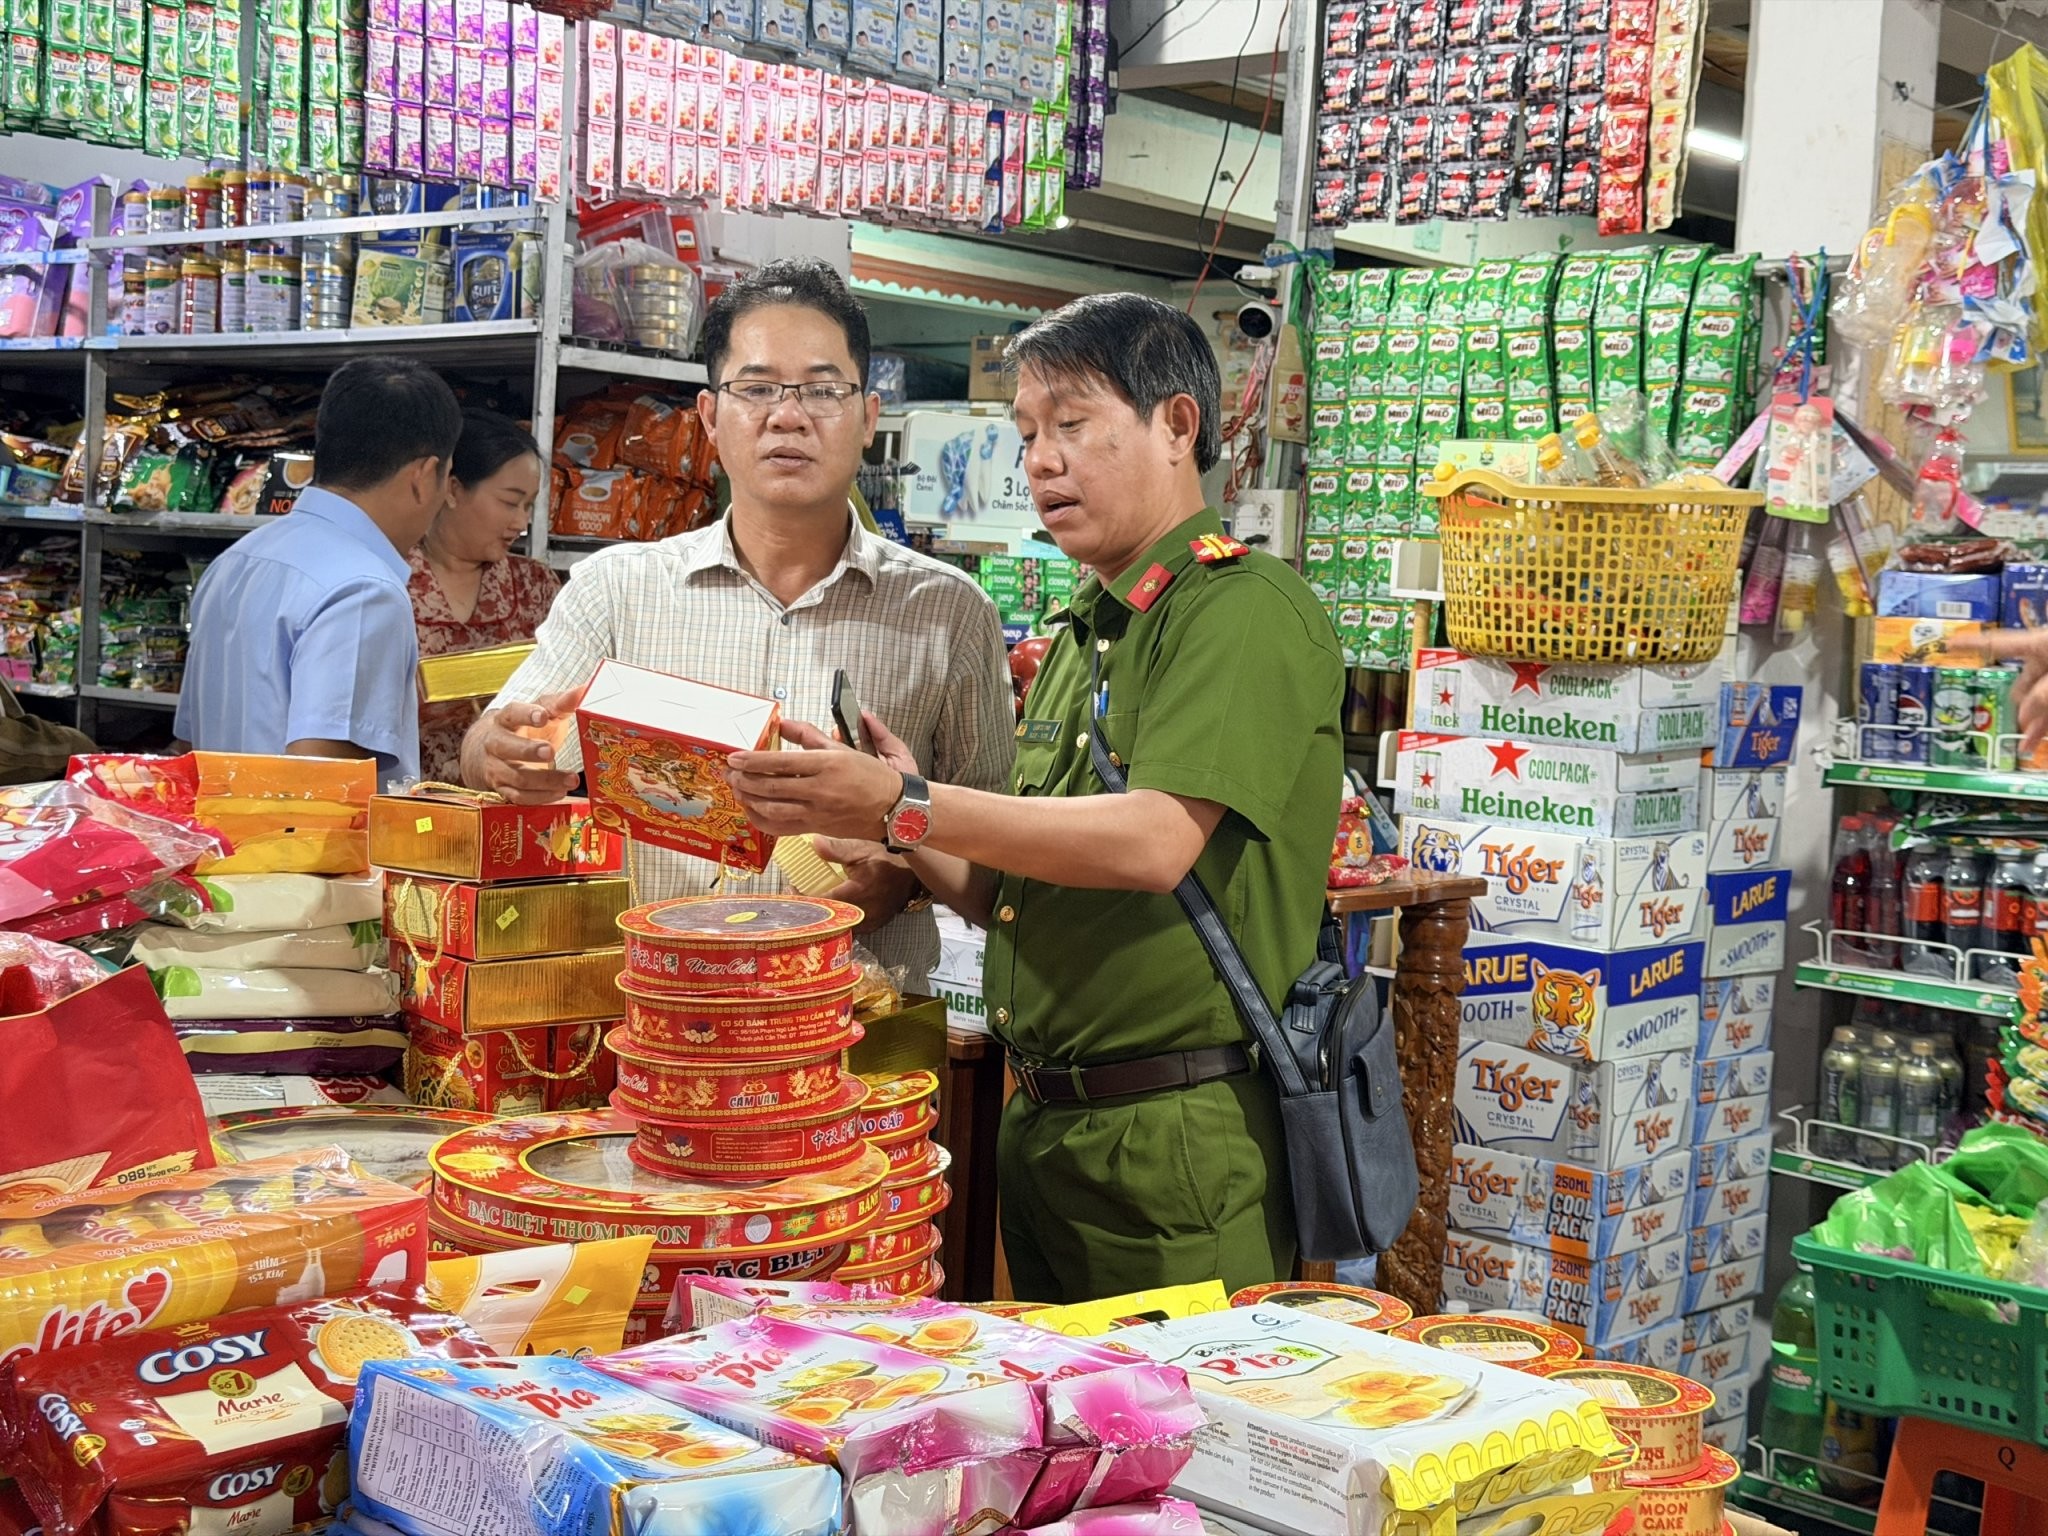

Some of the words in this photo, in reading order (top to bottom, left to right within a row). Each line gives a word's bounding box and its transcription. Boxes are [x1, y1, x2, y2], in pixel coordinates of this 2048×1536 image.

[1405, 272, 1429, 280] MILO
[1446, 270, 1469, 279] MILO
[1482, 266, 1506, 275] MILO
[1517, 270, 1542, 280] MILO
[1569, 266, 1593, 275] MILO
[1613, 269, 1638, 278] MILO
[1701, 322, 1730, 332] MILO
[1319, 346, 1341, 355] MILO
[1356, 340, 1376, 349] MILO
[1431, 339, 1455, 347] MILO
[1472, 337, 1495, 345] MILO
[1557, 336, 1580, 345] MILO
[1605, 342, 1629, 351] MILO
[1477, 407, 1500, 417] MILO
[1692, 397, 1722, 408] MILO
[1316, 414, 1339, 423] MILO
[1354, 409, 1373, 418] MILO
[1388, 410, 1409, 418] MILO
[1425, 409, 1450, 418] MILO
[1518, 414, 1544, 424] MILO
[1003, 477, 1013, 497] 3
[1313, 481, 1335, 489] MILO
[1015, 500, 1029, 512] Sóc
[1310, 548, 1331, 557] MILO
[1345, 546, 1364, 554] MILO
[1370, 615, 1394, 624] MILO
[1550, 674, 1612, 700] COOLPACK
[1480, 704, 1618, 743] Heineken
[1656, 711, 1705, 742] COOLPACK
[1751, 730, 1781, 760] Tiger
[1528, 758, 1591, 785] COOLPACK
[1460, 786, 1595, 828] Heineken
[1633, 795, 1683, 827] COOLPACK
[1733, 824, 1769, 864] Tiger
[1478, 843, 1566, 895] Tiger
[1494, 895, 1541, 911] CRYSTAL
[1731, 876, 1777, 919] LARUE
[1639, 897, 1685, 939] Tiger
[1463, 953, 1529, 987] ARUE
[1630, 949, 1685, 998] LARUE
[746, 1017, 768, 1027] BÁNH
[769, 1016, 794, 1025] TRUNG
[795, 1015, 809, 1023] THU
[1463, 1000, 1514, 1023] OOTH
[1624, 1005, 1680, 1049] SMOOTH
[1725, 1018, 1753, 1049] Tiger
[1469, 1057, 1561, 1113] Tiger
[878, 1107, 904, 1130] CẤP
[1486, 1111, 1536, 1129] CRYSTAL
[1634, 1112, 1674, 1154] Tiger
[117, 1167, 147, 1185] BBQ
[1449, 1156, 1520, 1205] Tiger
[1555, 1174, 1591, 1194] 250ML
[1457, 1203, 1498, 1220] CRYSTAL
[1551, 1192, 1594, 1220] COOL
[467, 1199, 500, 1226] ĐẶC
[502, 1208, 548, 1237] BIỆT
[551, 1218, 619, 1241] THƠM
[1548, 1216, 1593, 1241] PACK
[374, 1223, 417, 1251] TẶNG
[1444, 1239, 1516, 1288] Tiger
[1551, 1258, 1588, 1279] 250ML
[1454, 1285, 1496, 1303] CRYSTAL
[1548, 1277, 1592, 1305] COOL
[1545, 1299, 1590, 1326] PACK
[136, 1327, 270, 1385] COSY
[469, 1380, 541, 1402] Bánh
[218, 1392, 285, 1417] Marie
[37, 1392, 88, 1442] COSY
[1247, 1421, 1269, 1435] Attention:
[1269, 1429, 1289, 1442] Authentic
[1288, 1436, 1307, 1447] products
[1997, 1445, 2016, 1472] Q
[208, 1463, 284, 1502] COSY
[226, 1506, 263, 1529] Marie
[1639, 1502, 1689, 1516] MOON
[1642, 1516, 1684, 1530] CAKE
